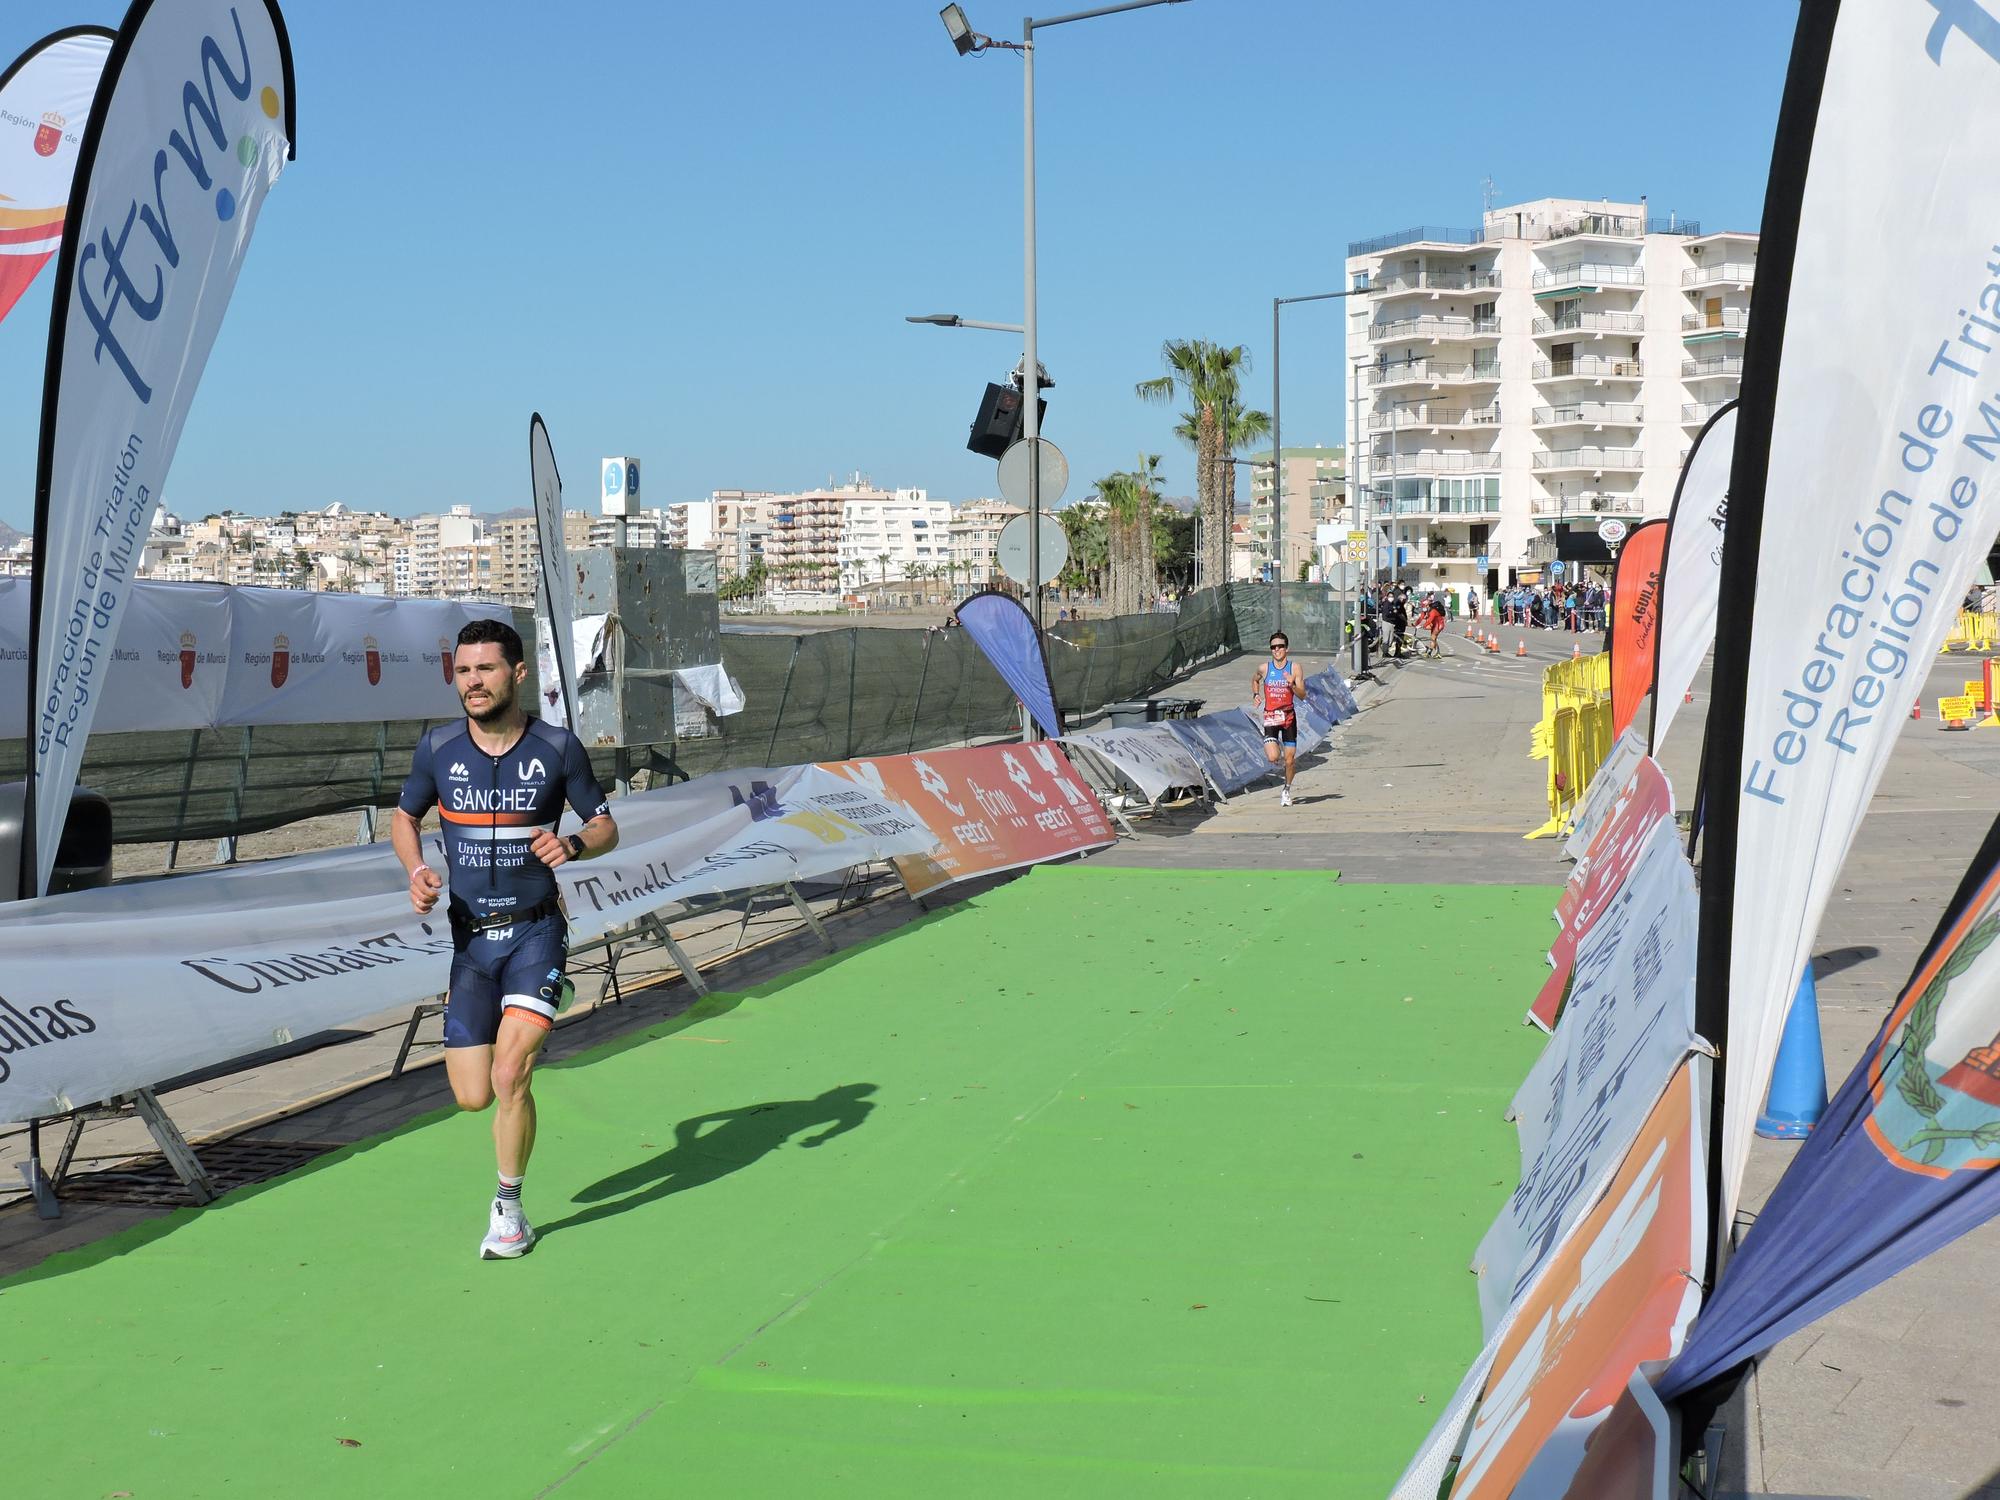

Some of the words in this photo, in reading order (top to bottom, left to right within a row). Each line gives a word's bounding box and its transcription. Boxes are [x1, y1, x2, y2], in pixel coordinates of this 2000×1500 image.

[0, 109, 35, 129] Región
[64, 133, 78, 144] de
[78, 7, 252, 404] ftrm
[104, 483, 151, 585] Murcia
[36, 597, 91, 777] ederación
[84, 550, 104, 589] de
[94, 431, 143, 539] Triatlón
[93, 591, 116, 630] de
[1743, 488, 1913, 806] Federación
[1898, 404, 1953, 473] de
[1825, 558, 1940, 754] Región
[1928, 476, 1977, 543] de
[115, 649, 140, 662] Murcia
[206, 653, 227, 664] Murcia
[245, 652, 271, 667] Región
[291, 652, 301, 664] de
[301, 652, 325, 664] Murcia
[342, 651, 365, 664] Región
[381, 652, 390, 663] de
[391, 652, 409, 663] Murcia
[54, 637, 100, 750] Región
[452, 785, 537, 811] SÁNCHEZ
[458, 841, 529, 855] Universitat
[459, 854, 525, 867] d'Alacant
[486, 927, 514, 942] BH
